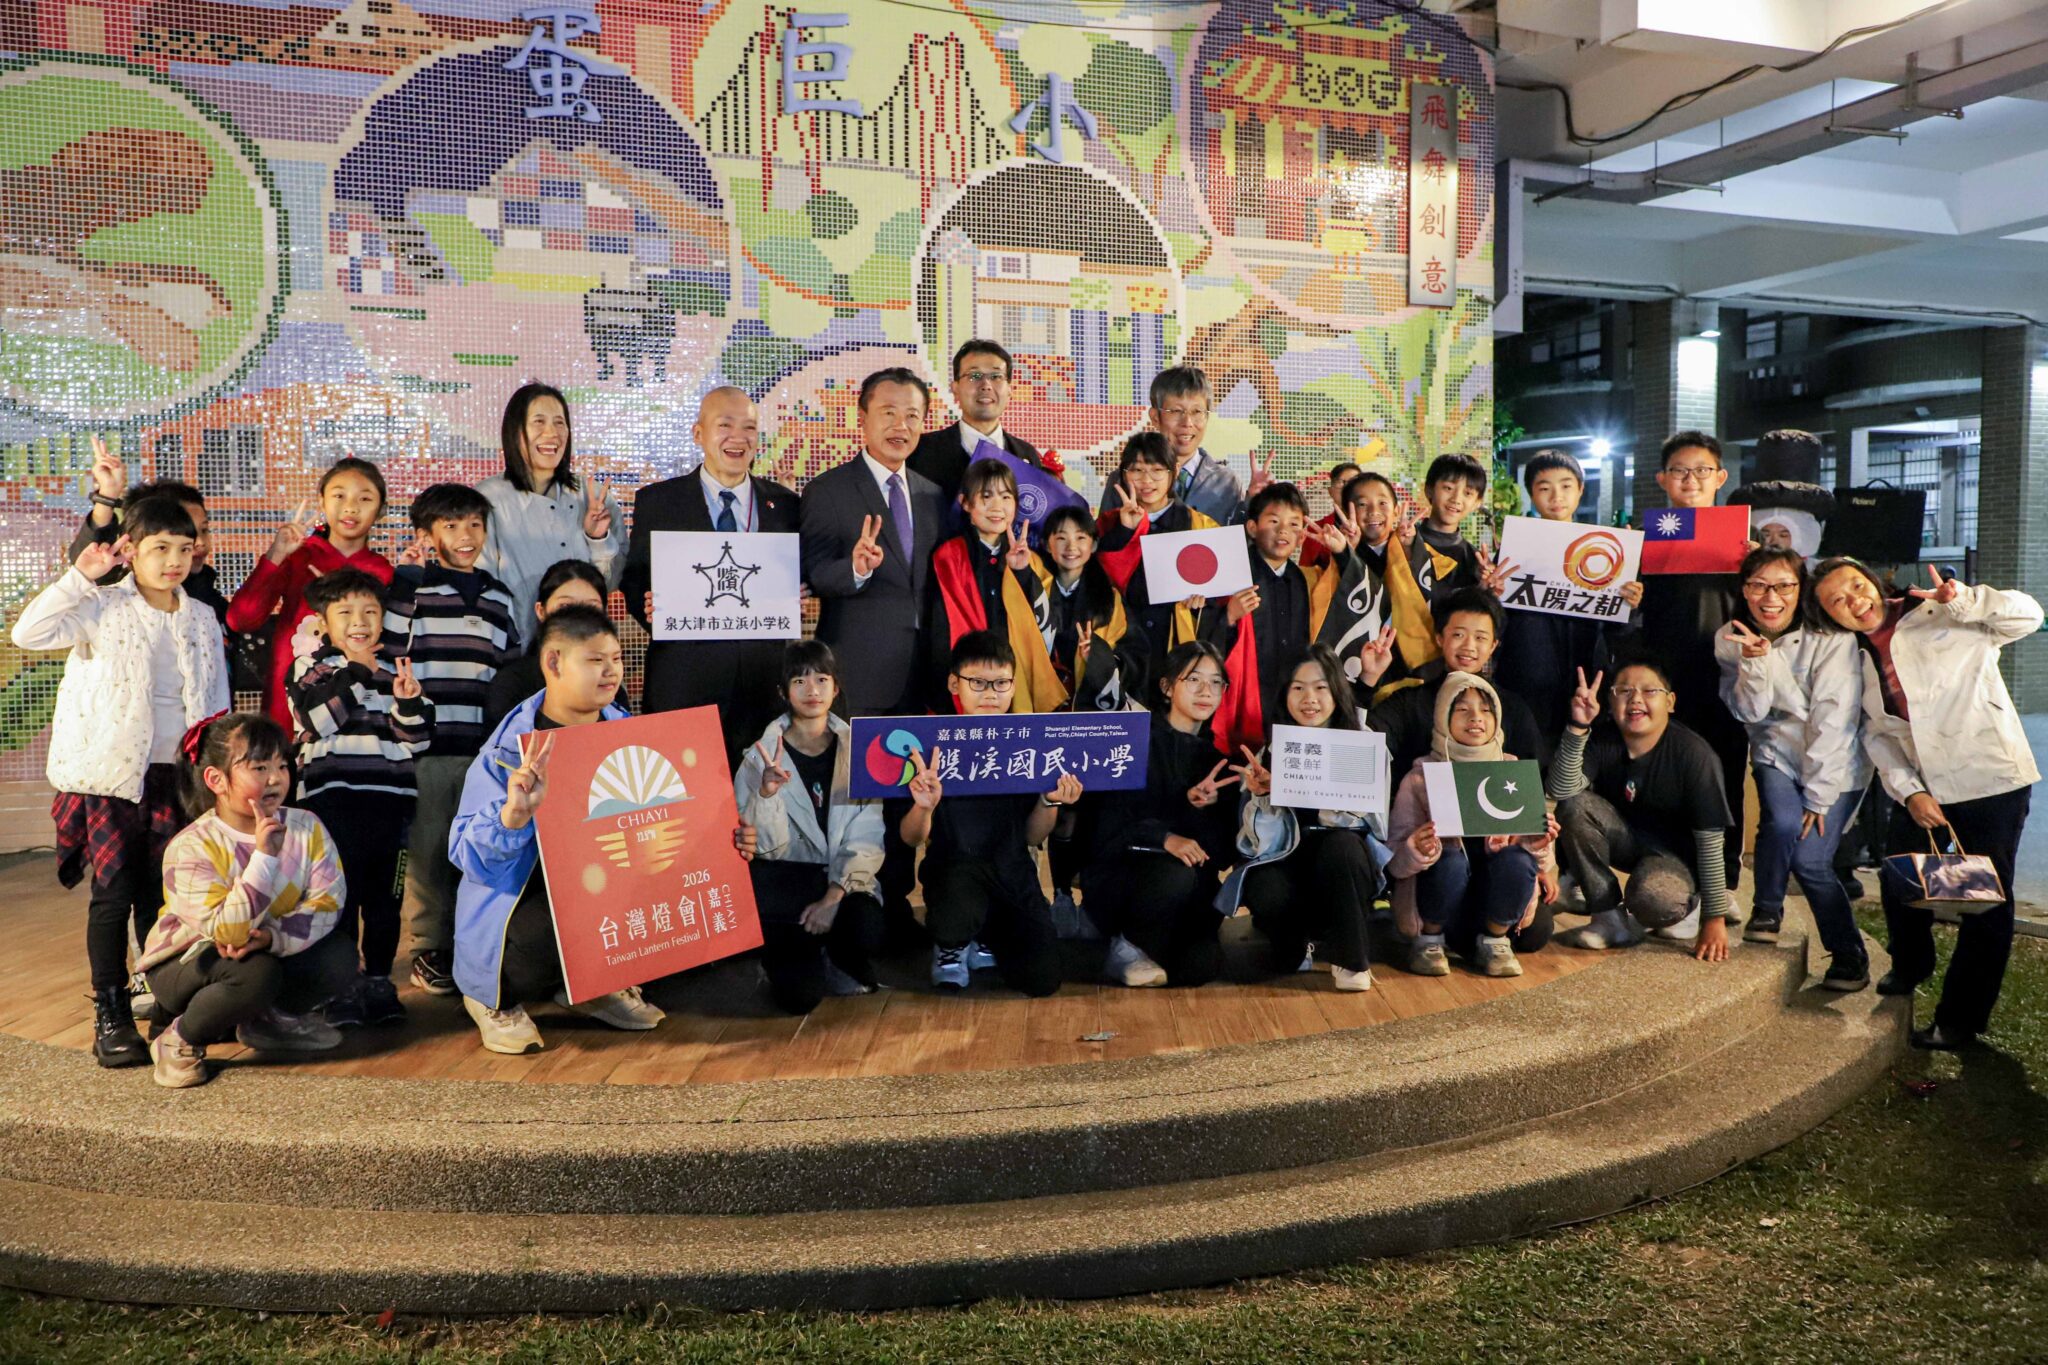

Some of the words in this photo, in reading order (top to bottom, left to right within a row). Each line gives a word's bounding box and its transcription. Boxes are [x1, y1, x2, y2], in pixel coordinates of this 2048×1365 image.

[1419, 94, 1449, 294] 飛舞創意
[1504, 573, 1625, 617] 太陽之都
[664, 616, 791, 631] 泉大津市立浜小学校
[937, 727, 1031, 741] 嘉義縣朴子市
[937, 744, 1134, 781] 雙溪國民小學
[617, 808, 668, 829] CHIAYI
[682, 869, 711, 888] 2026
[598, 895, 696, 950] 台灣燈會
[707, 887, 728, 934] 嘉義
[721, 884, 738, 930] CHIAYI
[605, 951, 638, 966] Taiwan
[638, 940, 670, 957] Lantern
[671, 929, 701, 948] Festival
